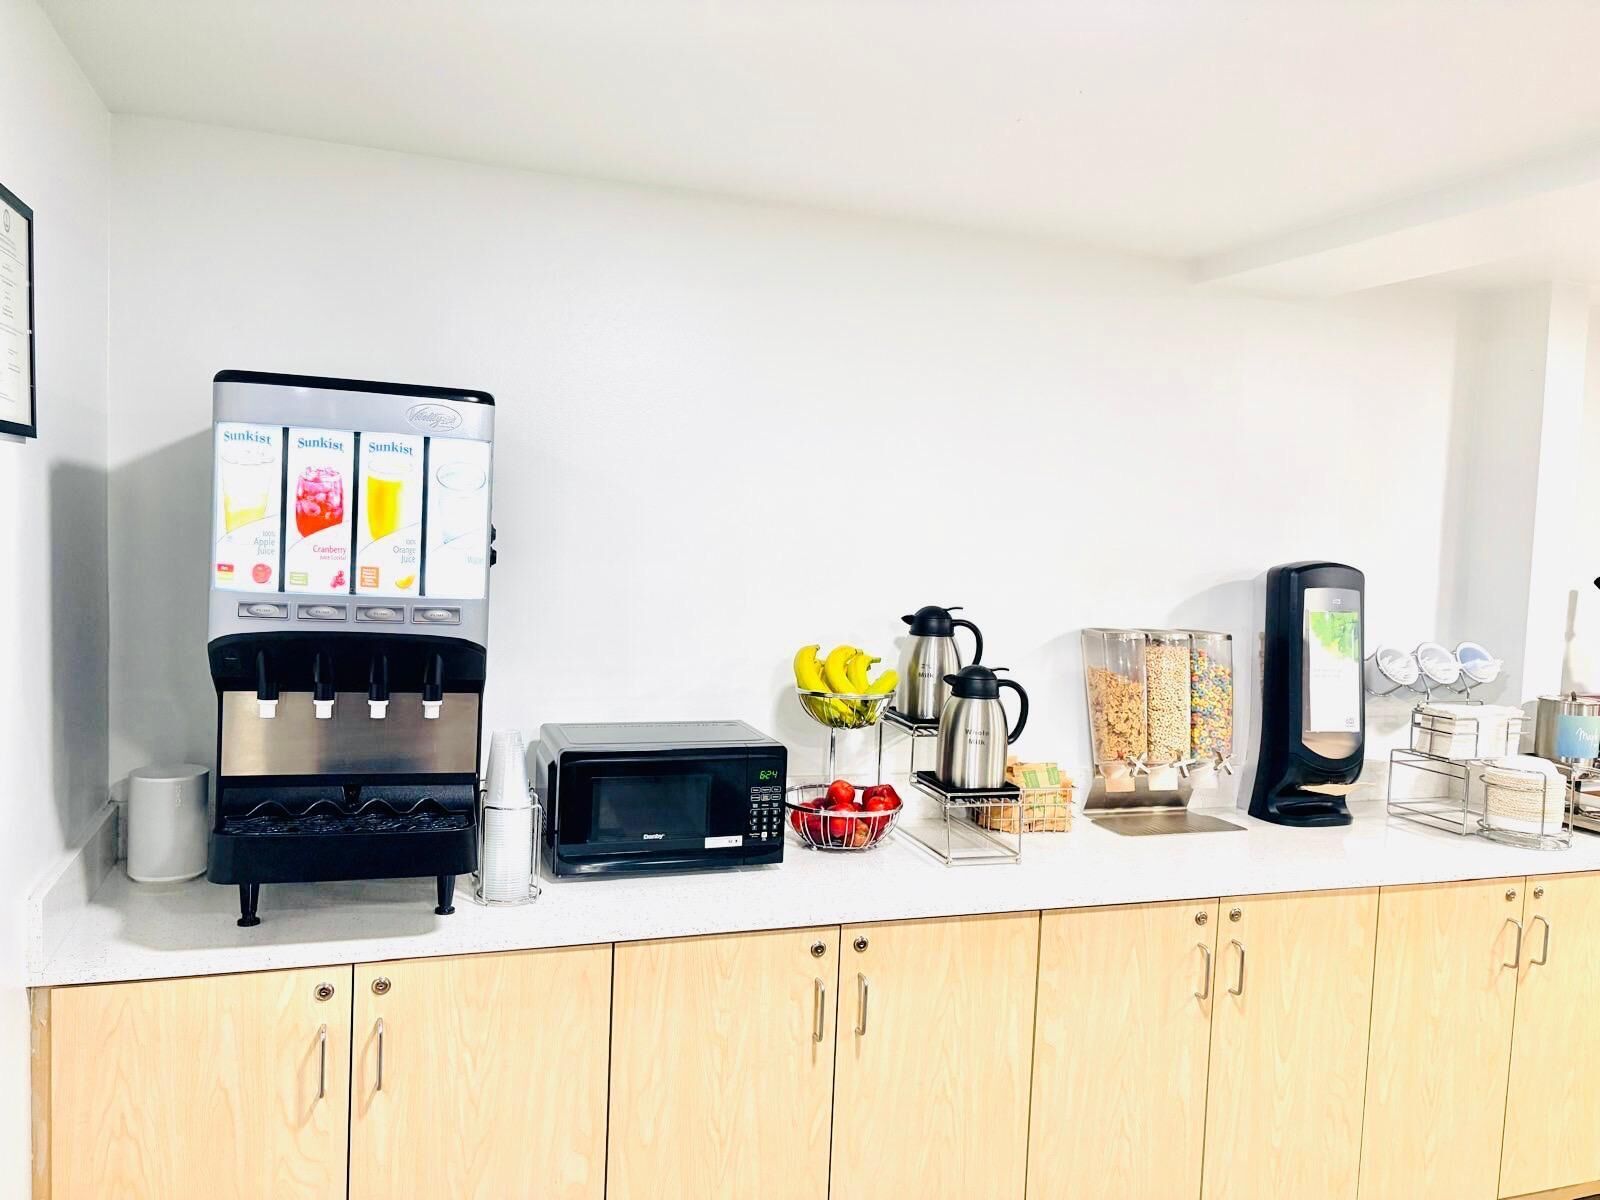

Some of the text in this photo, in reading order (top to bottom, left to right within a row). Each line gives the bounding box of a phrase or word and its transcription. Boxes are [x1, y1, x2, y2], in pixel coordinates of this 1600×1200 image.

[223, 430, 272, 446] Sunkist
[297, 436, 344, 453] Sunkist
[368, 441, 413, 456] Sunkist
[253, 537, 275, 548] Apple
[312, 544, 347, 556] Cranberry
[392, 545, 416, 556] Orange
[918, 671, 934, 679] Milk
[965, 728, 990, 736] Whole
[968, 738, 986, 746] Milk
